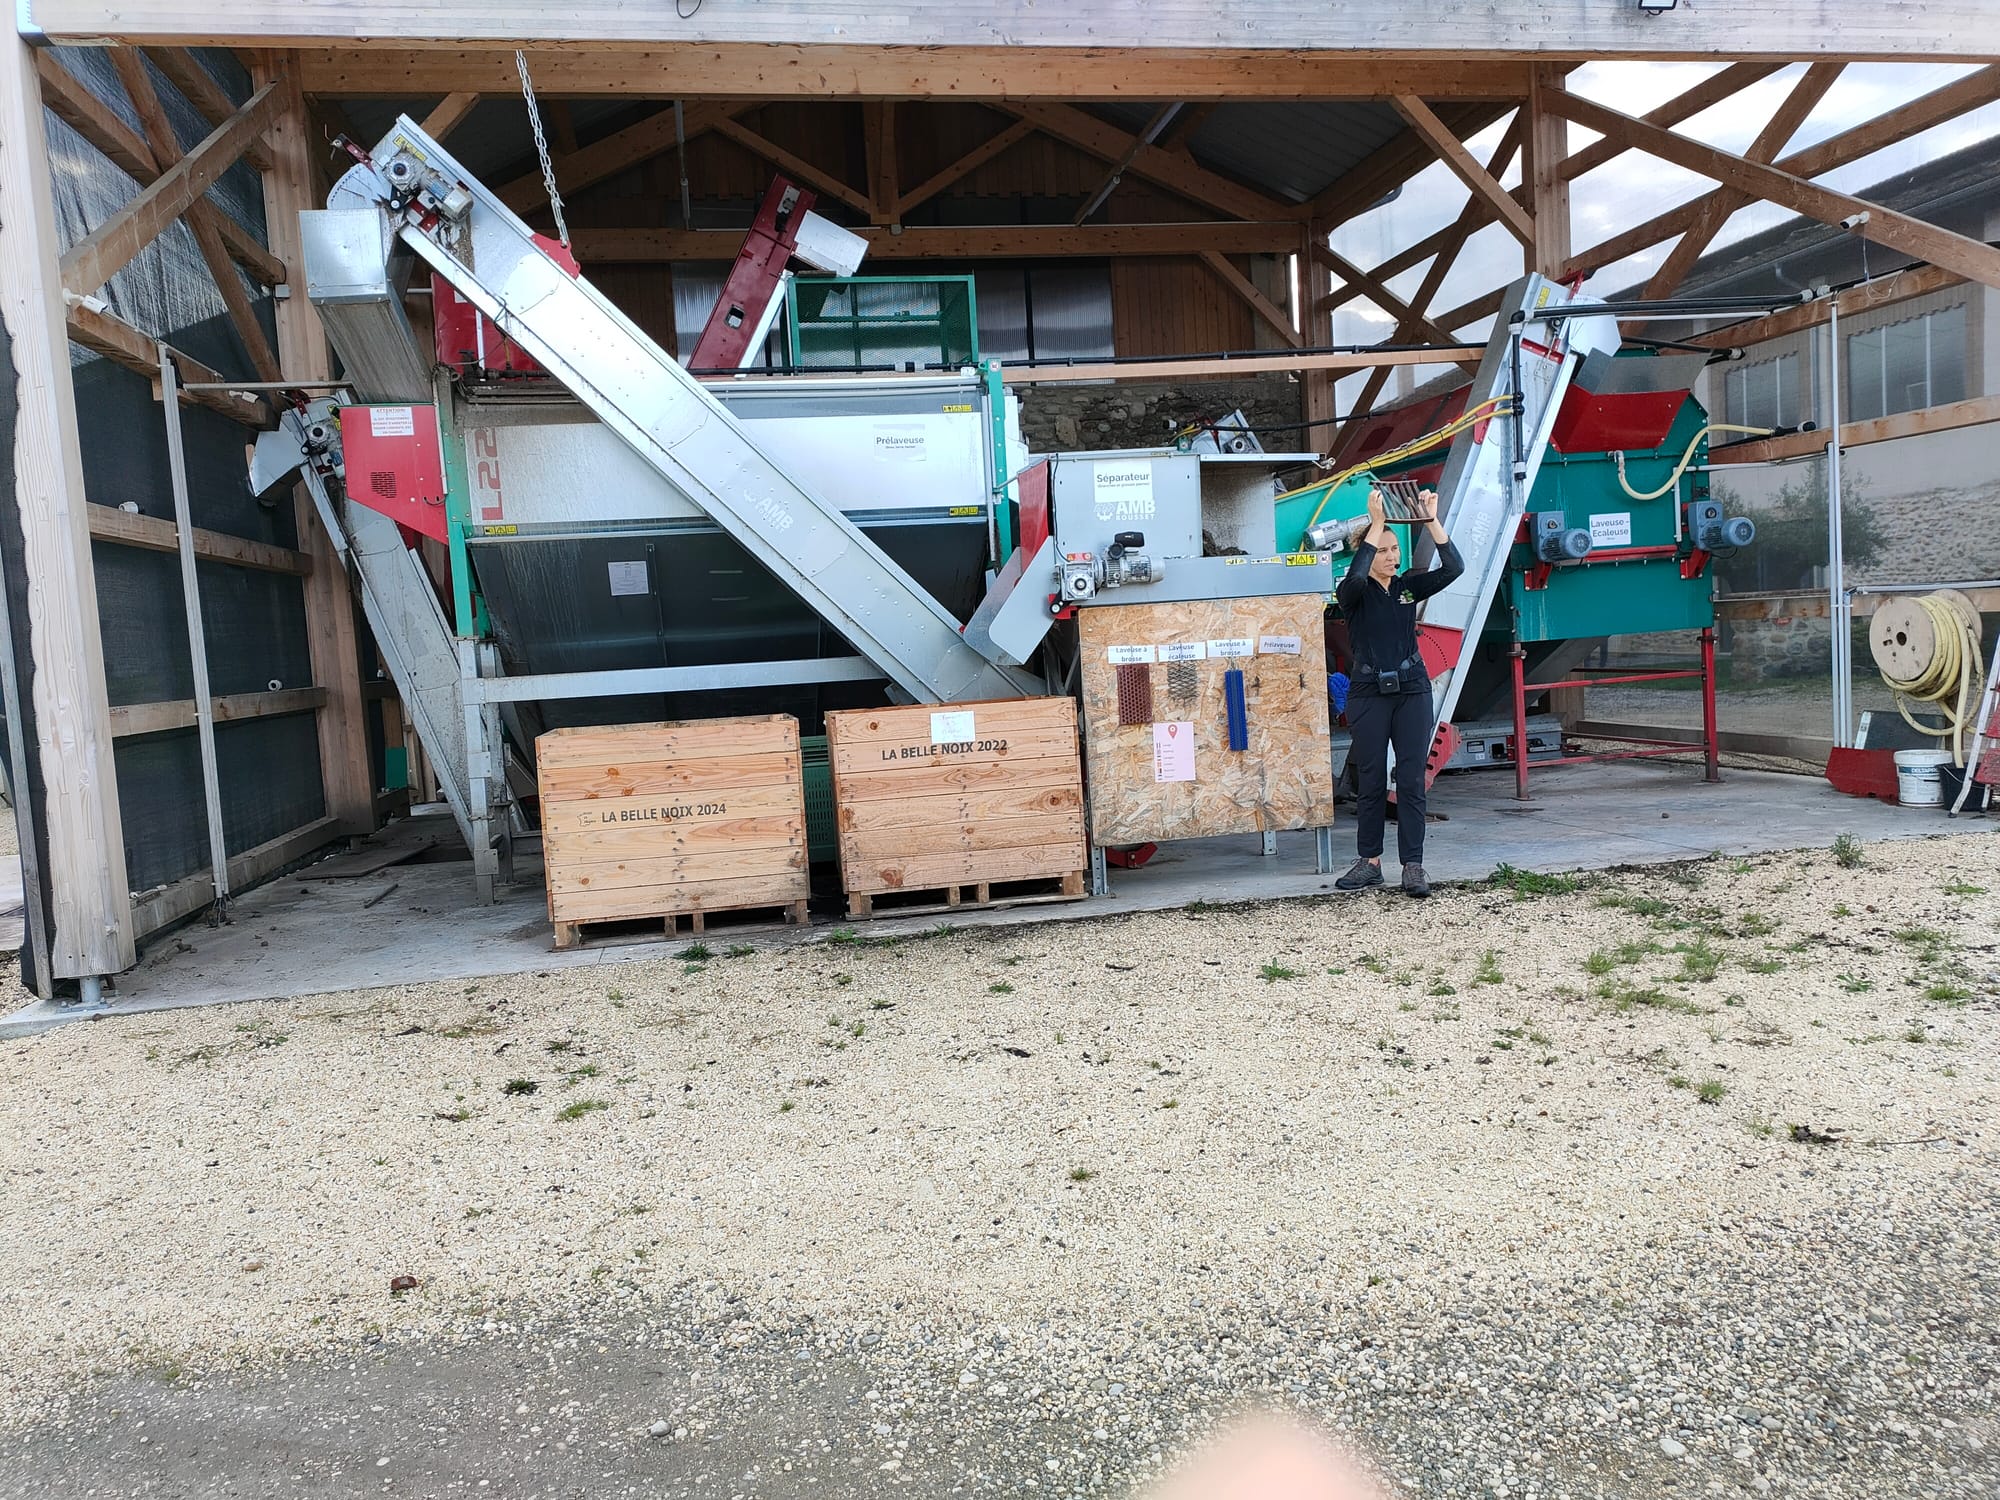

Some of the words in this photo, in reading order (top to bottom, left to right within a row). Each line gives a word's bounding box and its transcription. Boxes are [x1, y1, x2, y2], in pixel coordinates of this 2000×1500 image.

[876, 436, 925, 445] Prélaveuse
[474, 427, 504, 521] L22
[1096, 471, 1150, 485] Séparateur
[1116, 500, 1156, 515] AMB
[1591, 519, 1625, 528] Laveuse
[1592, 529, 1629, 538] Ecaleuse
[882, 749, 897, 760] LA
[901, 745, 938, 759] BELLE
[942, 742, 974, 755] NOIX
[977, 740, 1008, 752] 2022
[602, 811, 617, 823] LA
[621, 808, 657, 822] BELLE
[661, 805, 693, 818] NOIX
[697, 803, 727, 816] 2024
